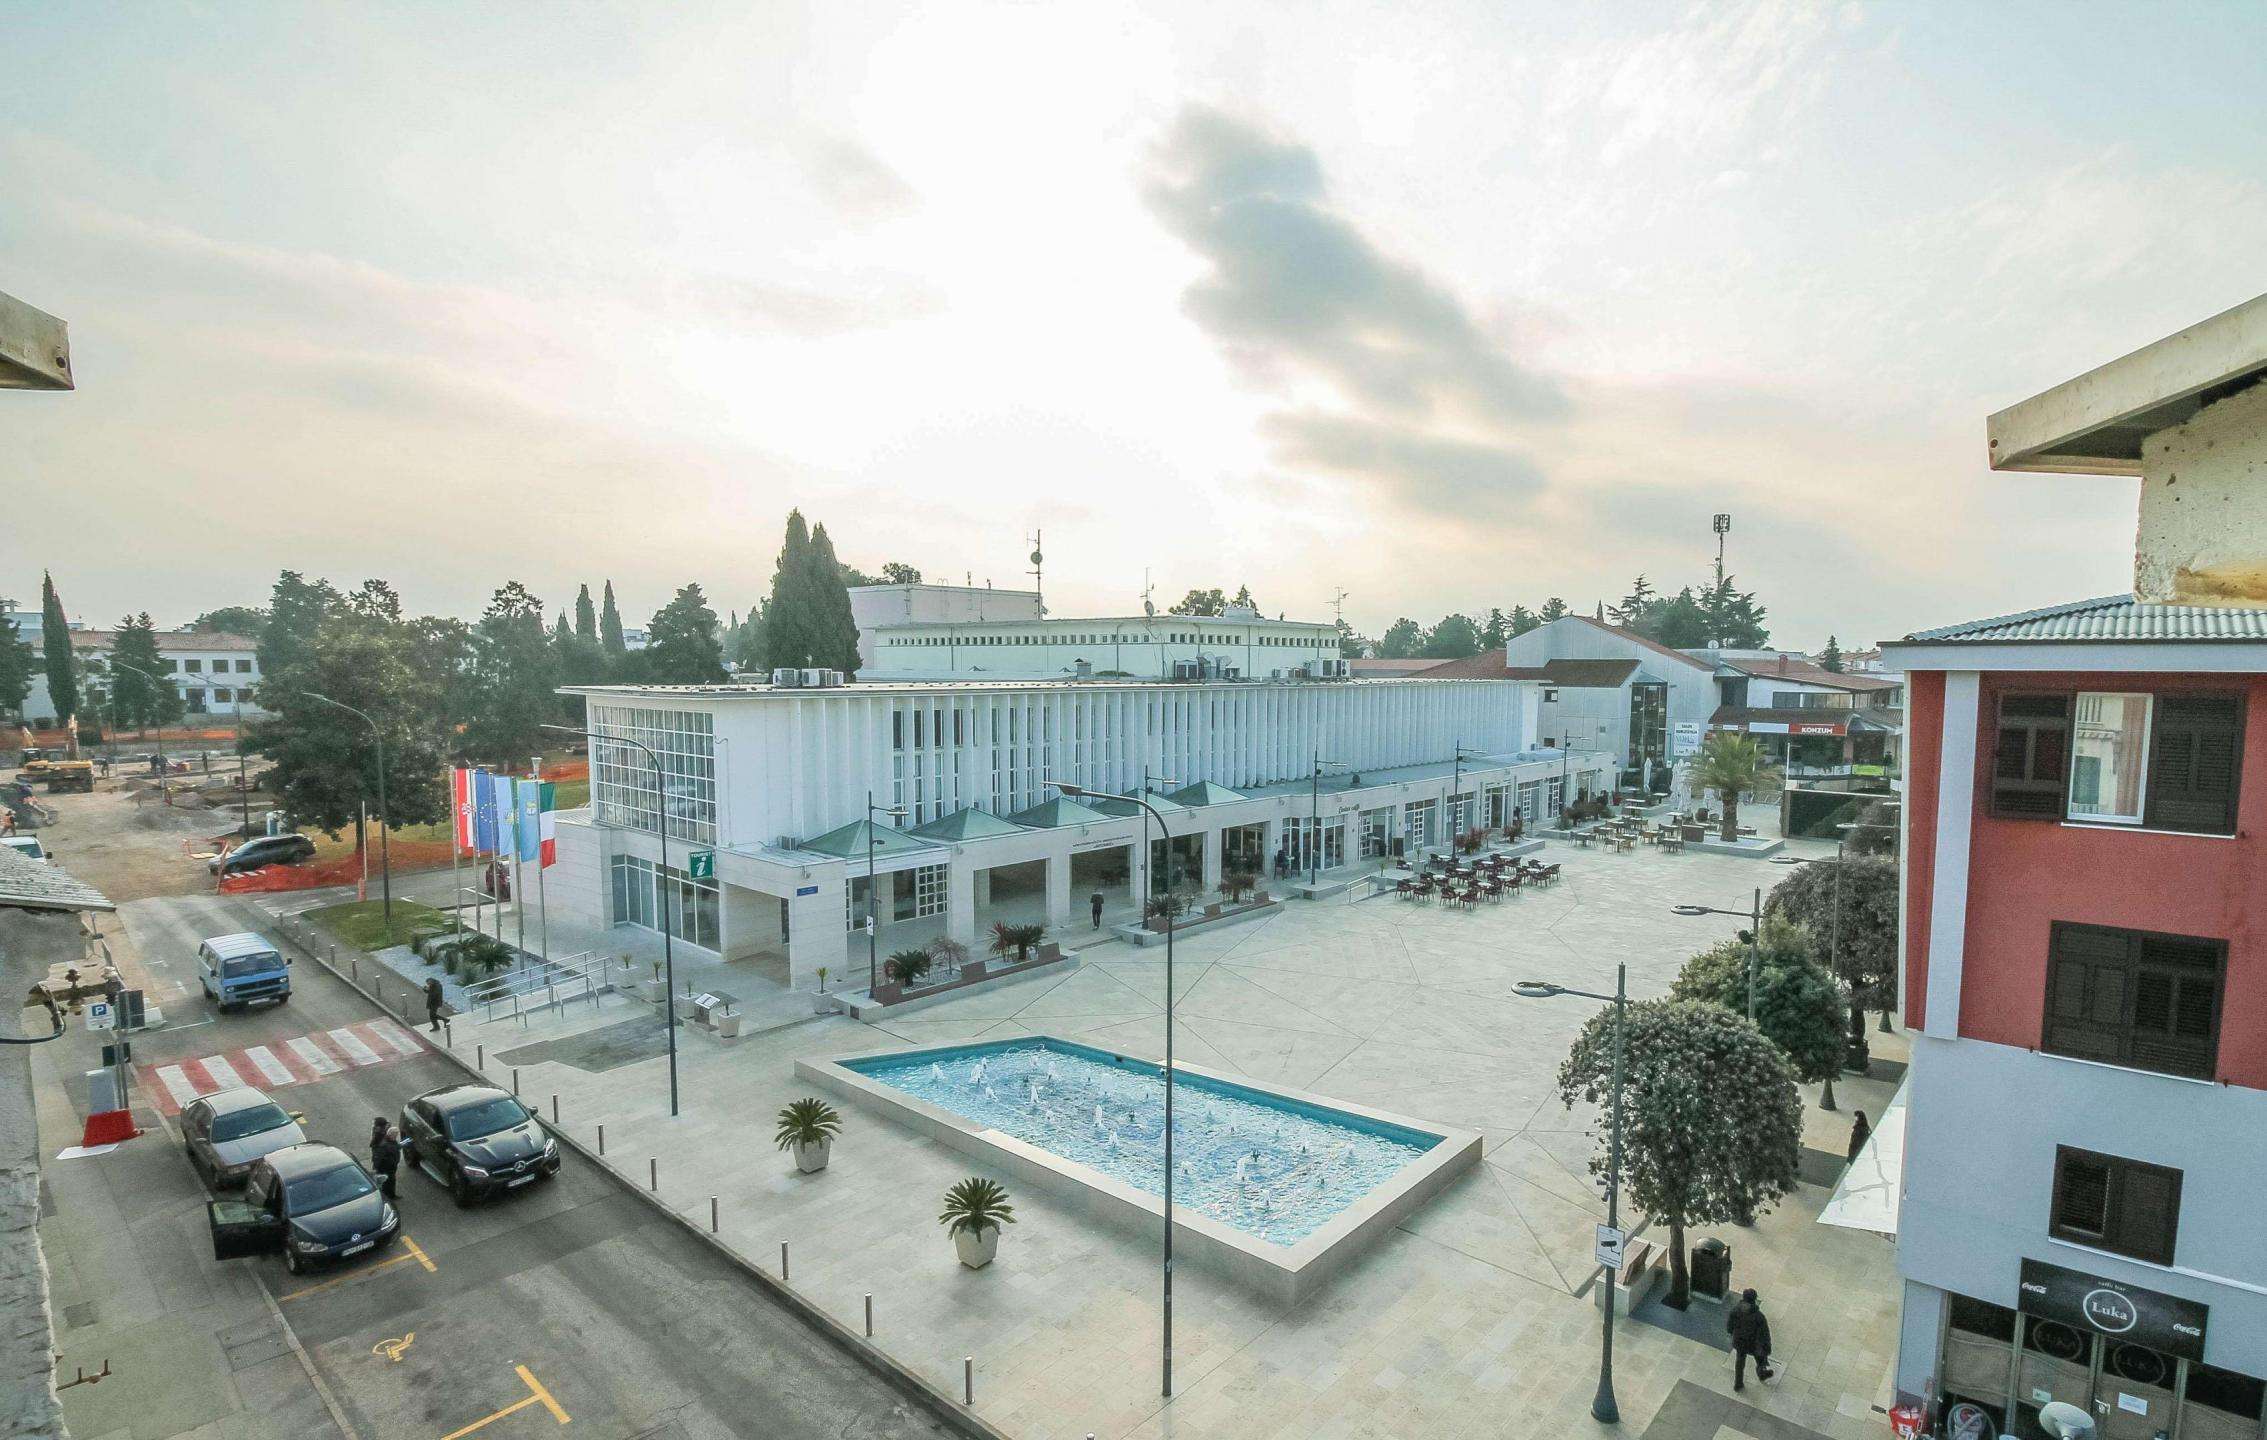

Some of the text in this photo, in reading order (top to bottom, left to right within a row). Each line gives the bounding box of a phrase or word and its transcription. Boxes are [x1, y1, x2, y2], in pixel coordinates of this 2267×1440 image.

[1801, 727, 1833, 735] KONZUM
[95, 1006, 104, 1015] P
[2091, 1301, 2128, 1321] Luka
